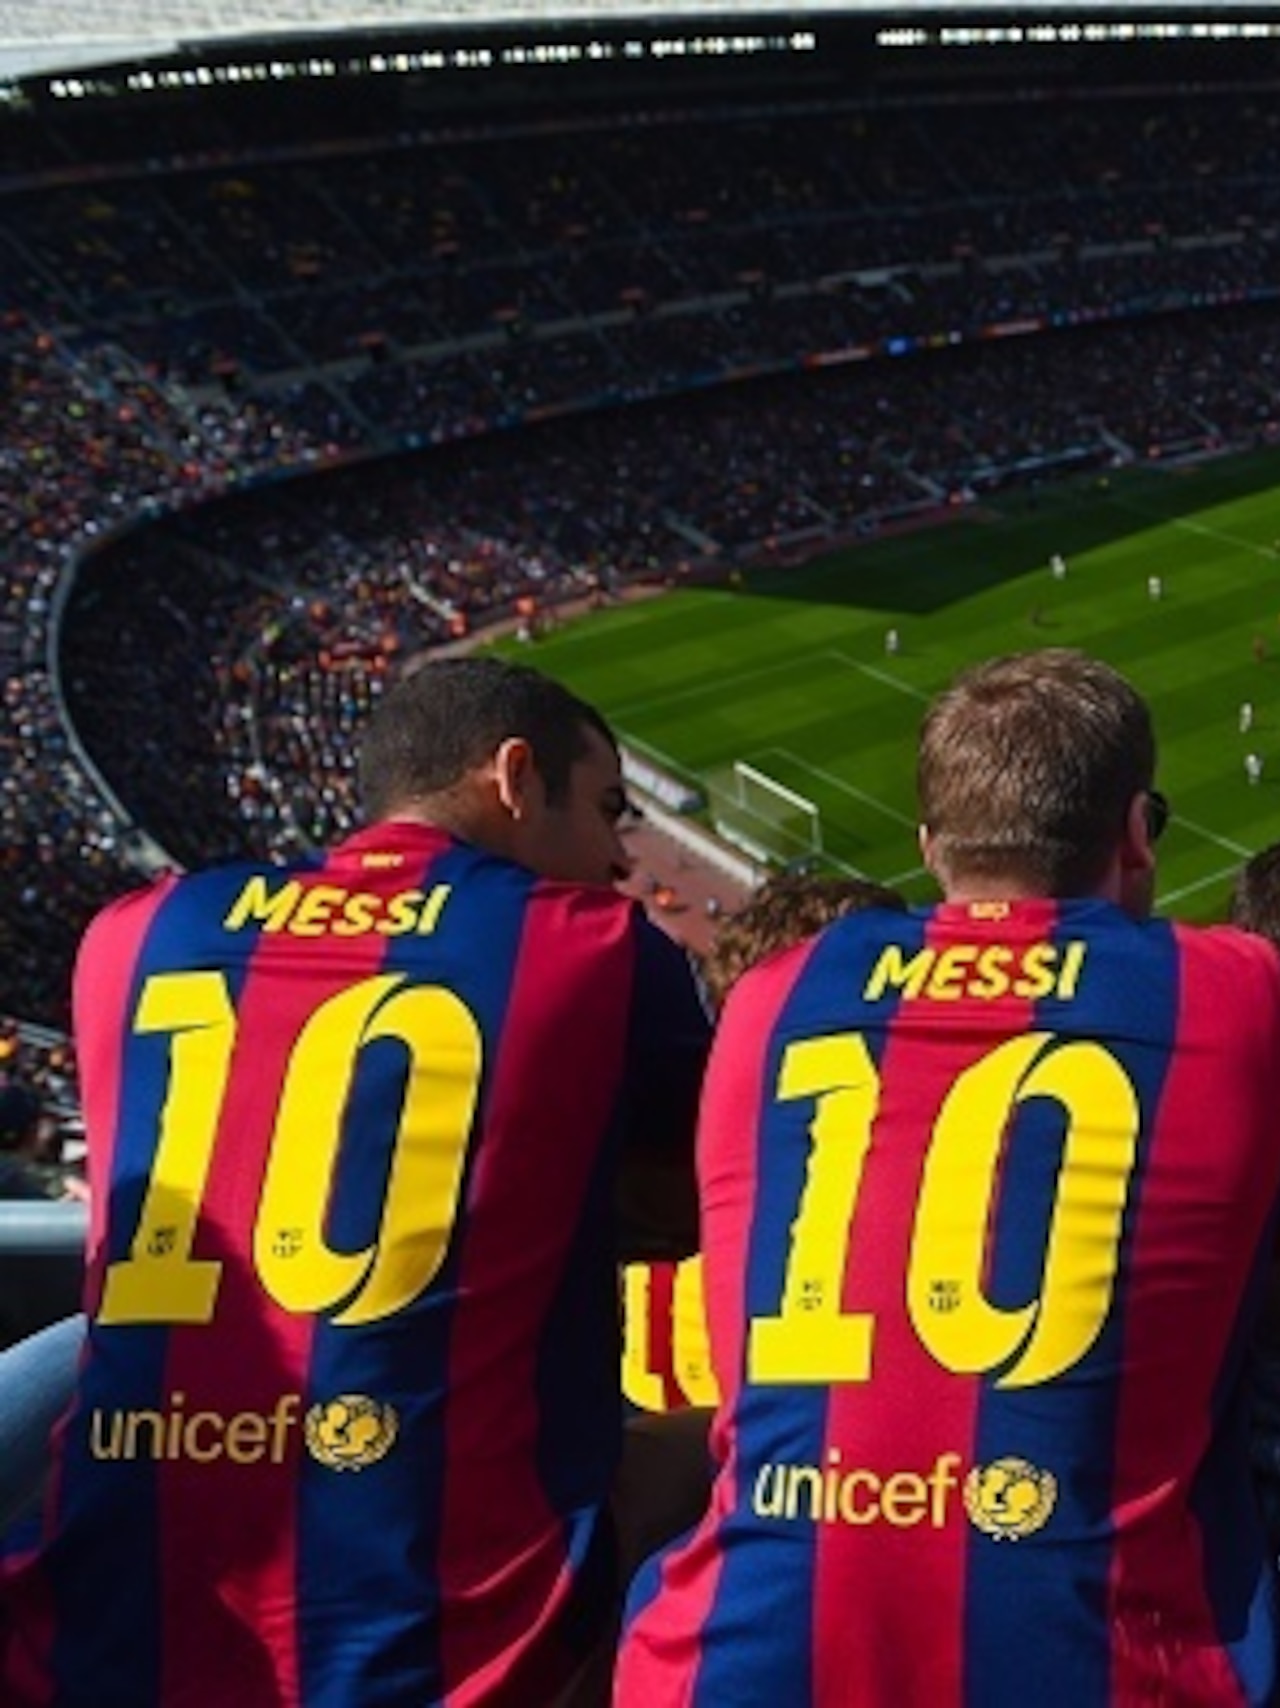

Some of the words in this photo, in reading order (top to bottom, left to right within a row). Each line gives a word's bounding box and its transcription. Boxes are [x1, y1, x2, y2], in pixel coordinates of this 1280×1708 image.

[224, 877, 451, 938] MESSI
[864, 941, 1087, 1001] MESSI
[98, 970, 484, 1326] 10
[744, 1031, 1141, 1389] 10
[90, 1391, 299, 1464] unicef
[752, 1448, 959, 1528] unicef
